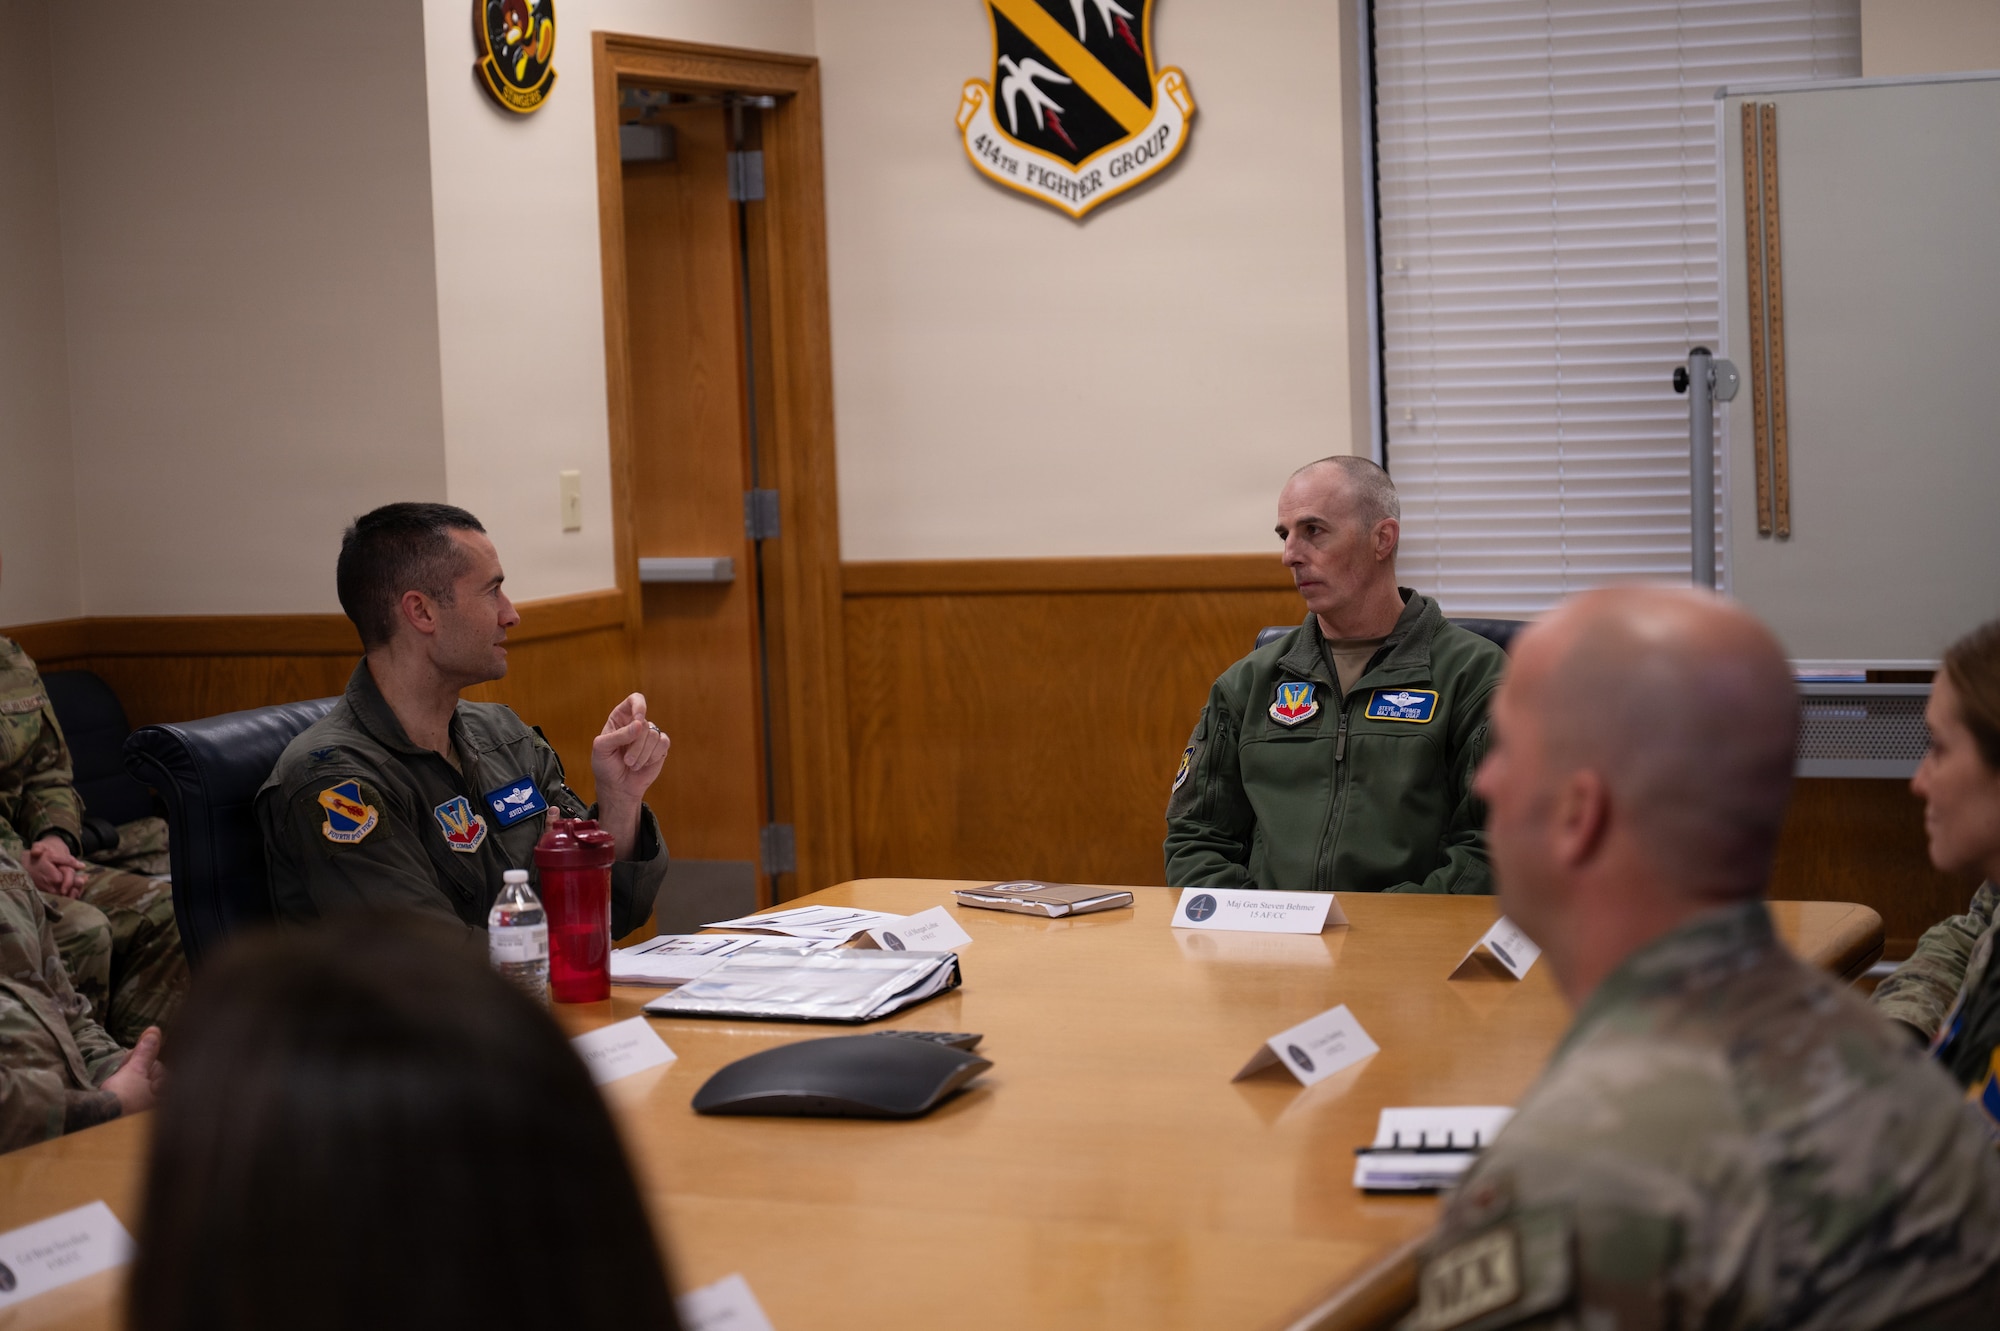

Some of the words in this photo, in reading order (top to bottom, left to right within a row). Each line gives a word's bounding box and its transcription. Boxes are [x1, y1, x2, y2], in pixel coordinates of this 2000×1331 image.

[1026, 163, 1103, 202] FIGHTER
[1109, 124, 1170, 179] GROUP
[328, 830, 350, 840] FOURTH
[1226, 900, 1241, 909] Maj
[1243, 900, 1258, 909] Gen
[1260, 902, 1285, 910] Steven
[1286, 903, 1315, 911] Behmer
[1250, 910, 1259, 918] 15
[1260, 911, 1287, 919] AF/CC
